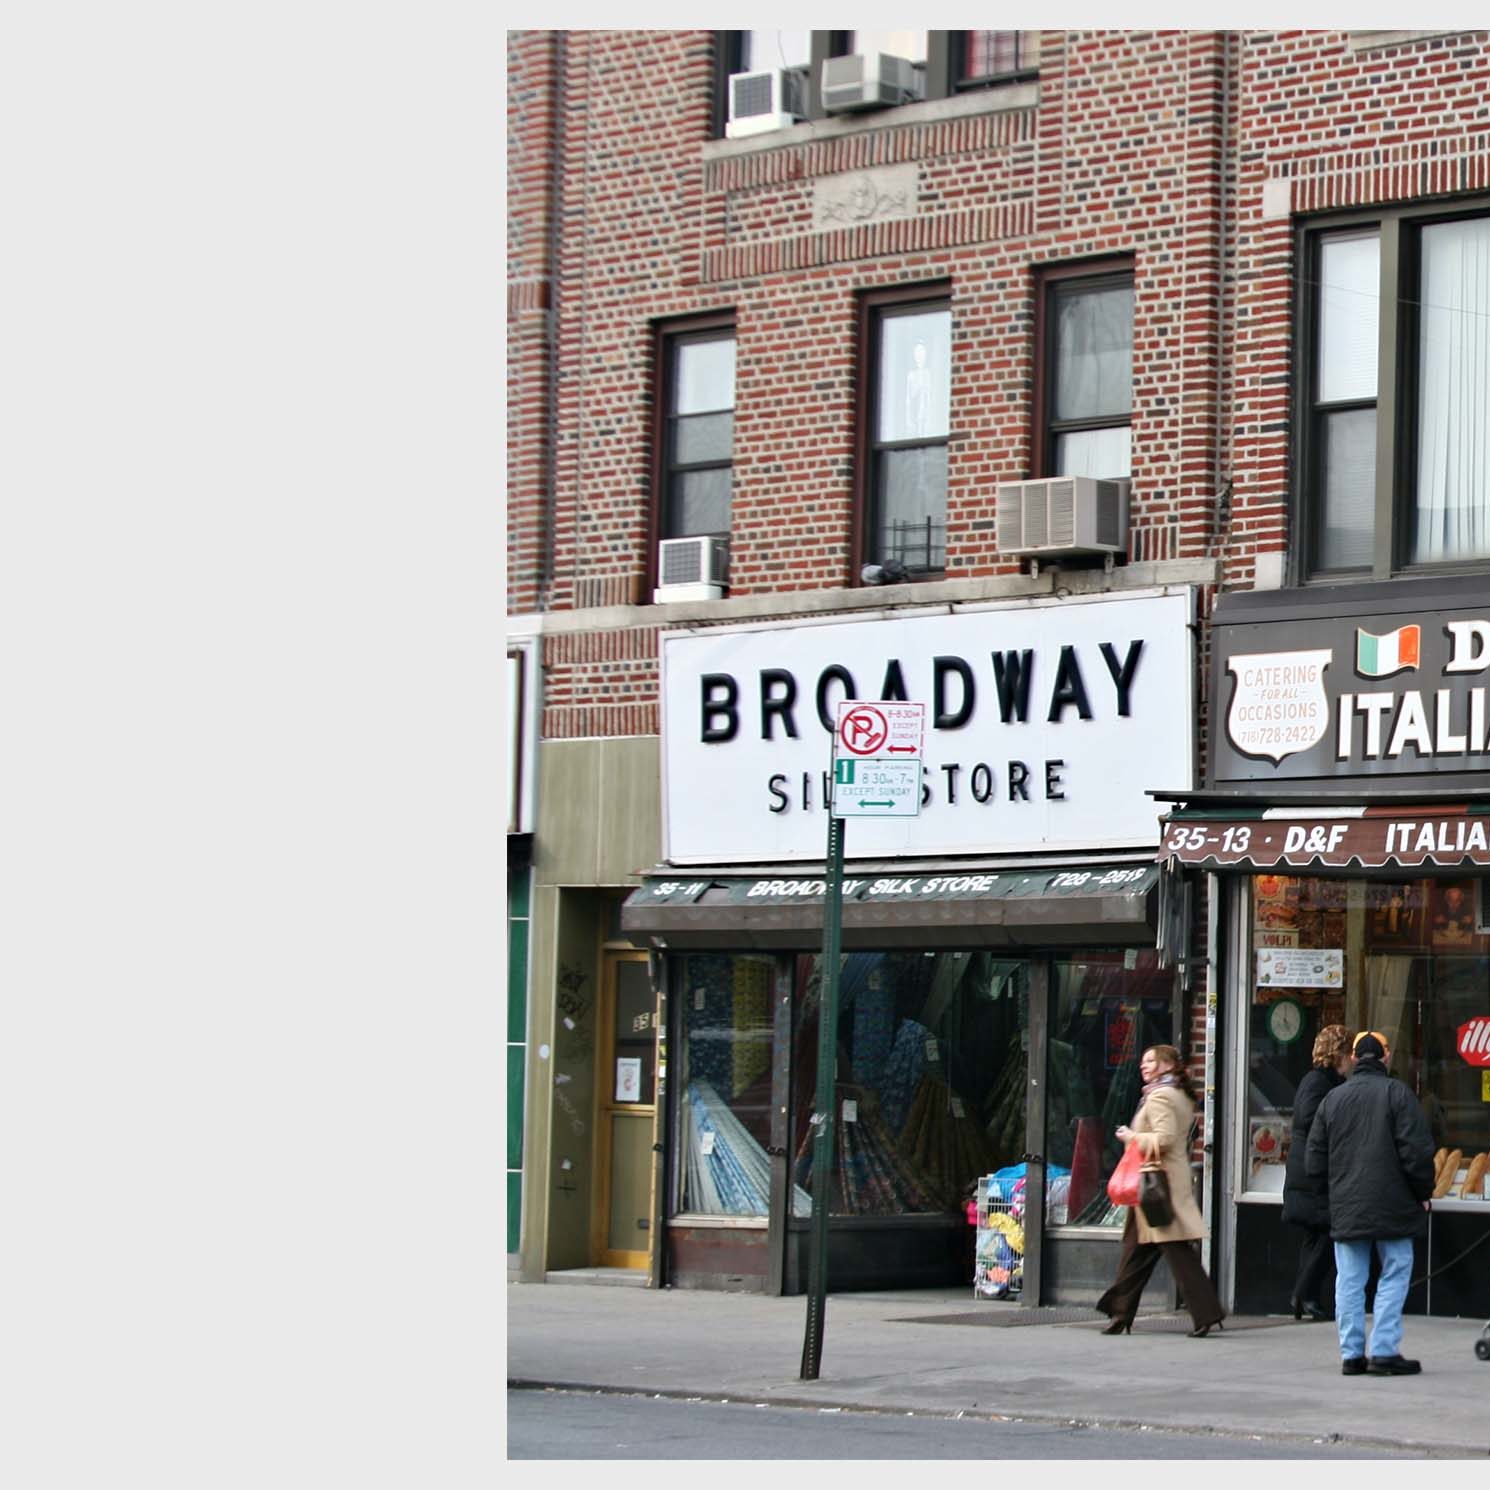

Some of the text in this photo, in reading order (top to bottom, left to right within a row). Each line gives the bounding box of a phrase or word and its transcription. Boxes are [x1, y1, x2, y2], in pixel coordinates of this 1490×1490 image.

[1244, 664, 1317, 687] CATERING
[700, 639, 1144, 743] BROADWAY
[1261, 687, 1298, 700] FOR ALL
[1238, 702, 1317, 721] OCCASIONS
[841, 761, 849, 783] 1
[768, 770, 833, 813] SIL
[842, 787, 910, 796] EXCEPT SUNDAY
[1168, 826, 1251, 853] 35-13
[1283, 824, 1348, 854] D&F
[654, 882, 704, 896] 35-11
[869, 878, 919, 894] SILK
[922, 875, 999, 894] STORE
